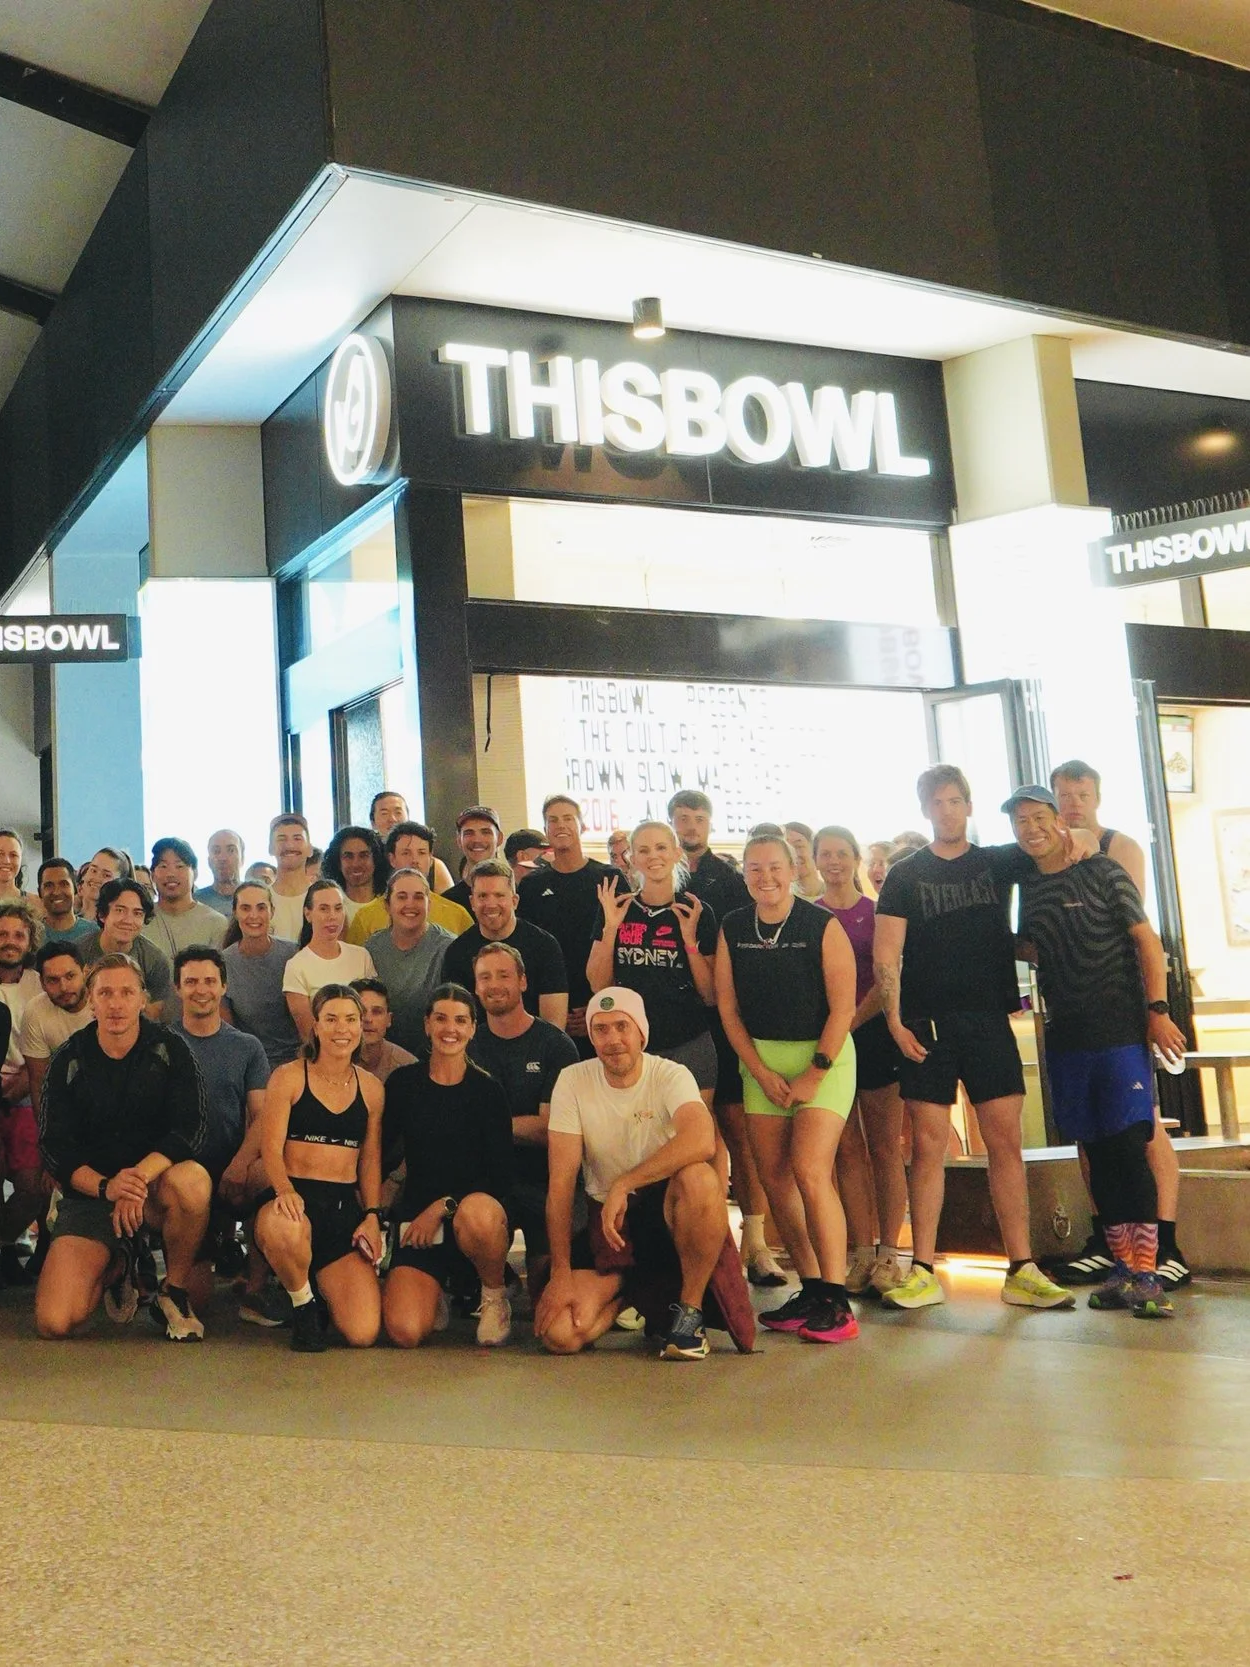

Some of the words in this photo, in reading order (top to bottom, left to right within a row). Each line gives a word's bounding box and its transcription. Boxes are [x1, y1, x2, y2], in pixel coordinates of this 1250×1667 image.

[438, 343, 930, 477] THISBOWL
[579, 719, 611, 752] THE
[618, 922, 647, 932] AFTER
[619, 929, 643, 938] DARK
[619, 935, 643, 945] TOUR
[617, 947, 678, 968] SYDNEY
[304, 1134, 327, 1142] NIKE
[344, 1139, 358, 1147] NIKE
